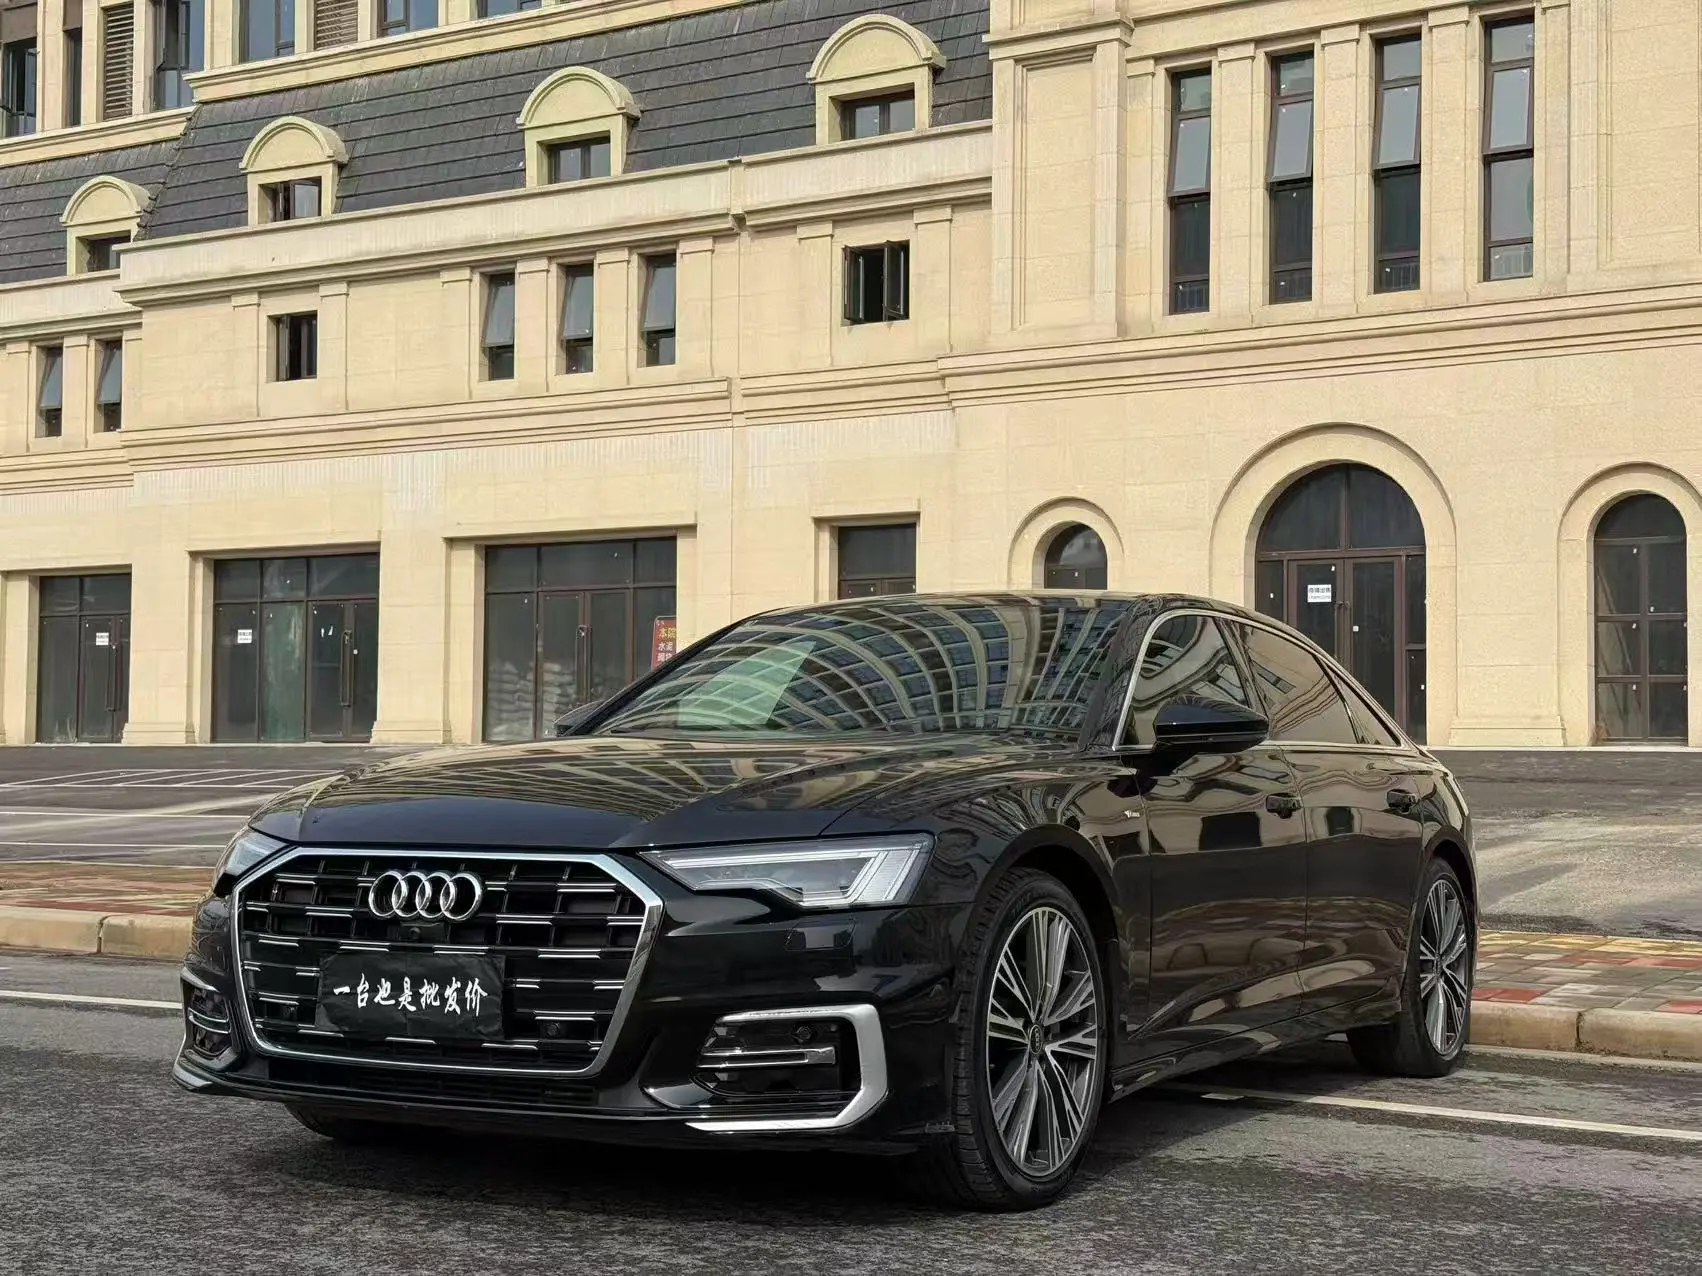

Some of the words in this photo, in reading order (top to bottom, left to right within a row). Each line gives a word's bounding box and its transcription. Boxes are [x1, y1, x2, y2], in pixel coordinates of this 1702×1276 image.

[333, 972, 488, 1017] 一台也是批发价
